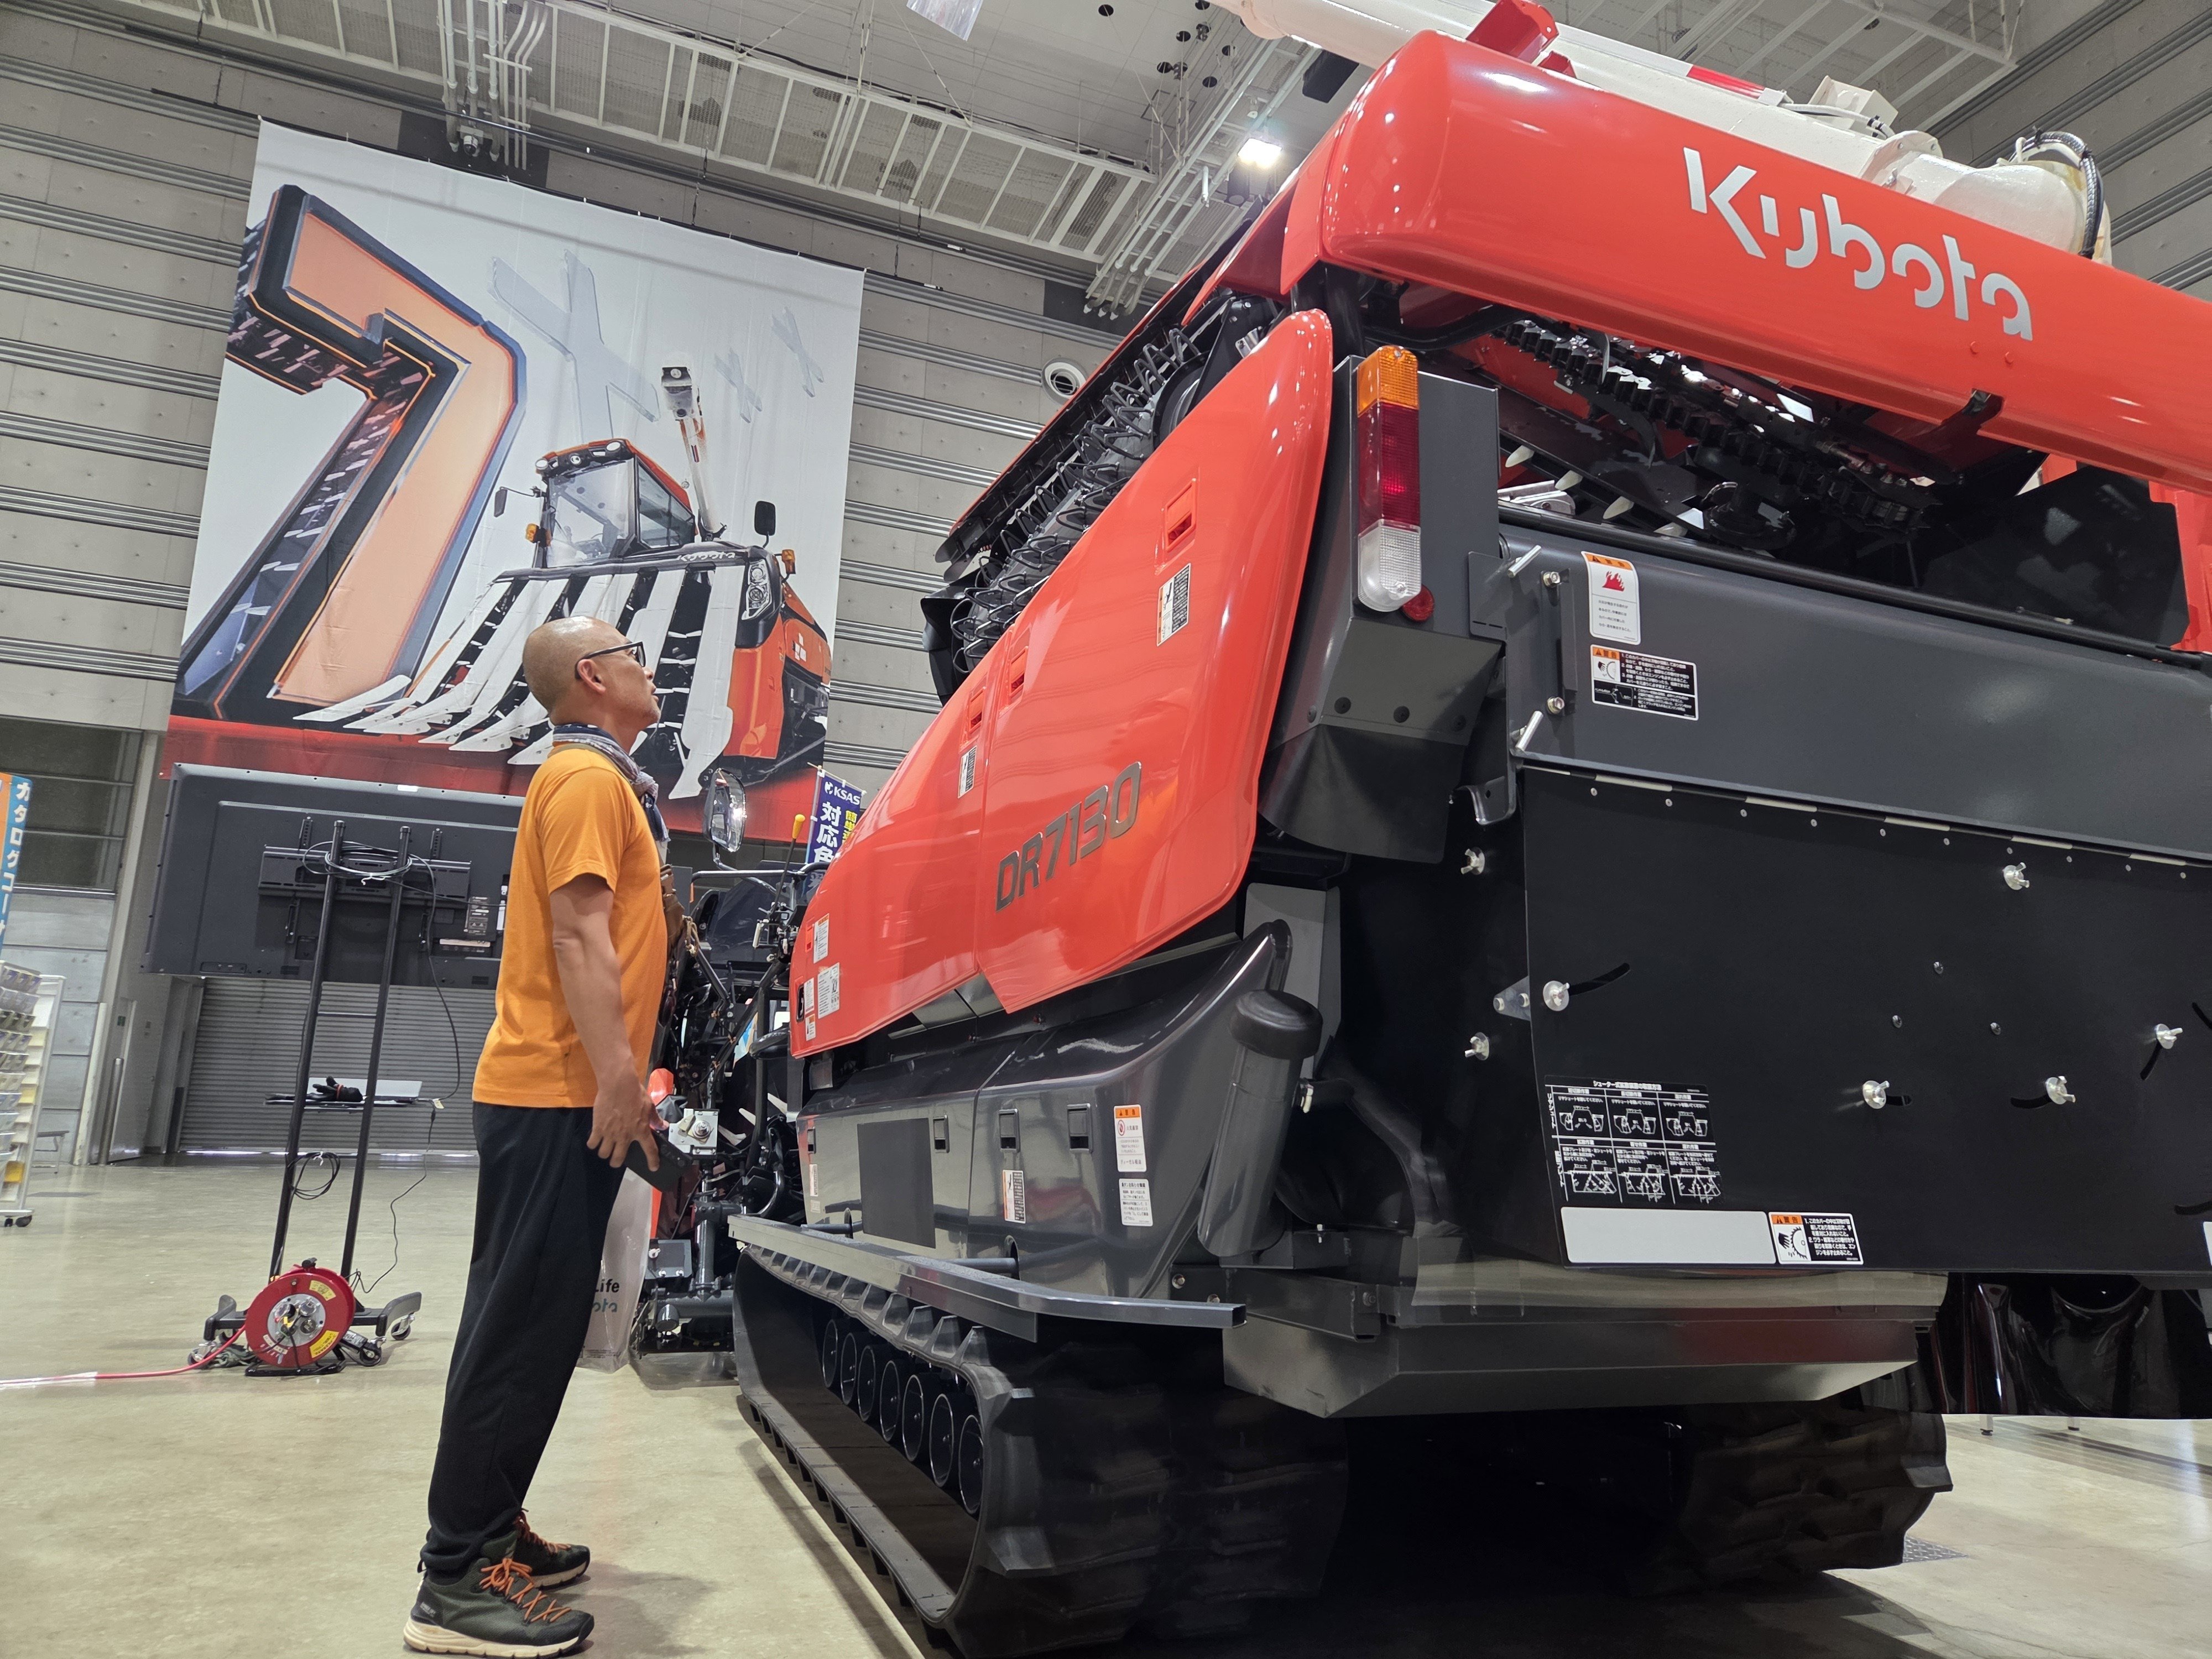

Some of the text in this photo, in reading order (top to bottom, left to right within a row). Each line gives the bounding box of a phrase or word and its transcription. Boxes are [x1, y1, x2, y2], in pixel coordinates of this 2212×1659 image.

[1683, 147, 2032, 341] Kubota
[833, 786, 860, 806] KSAS
[995, 761, 1142, 913] DR7130
